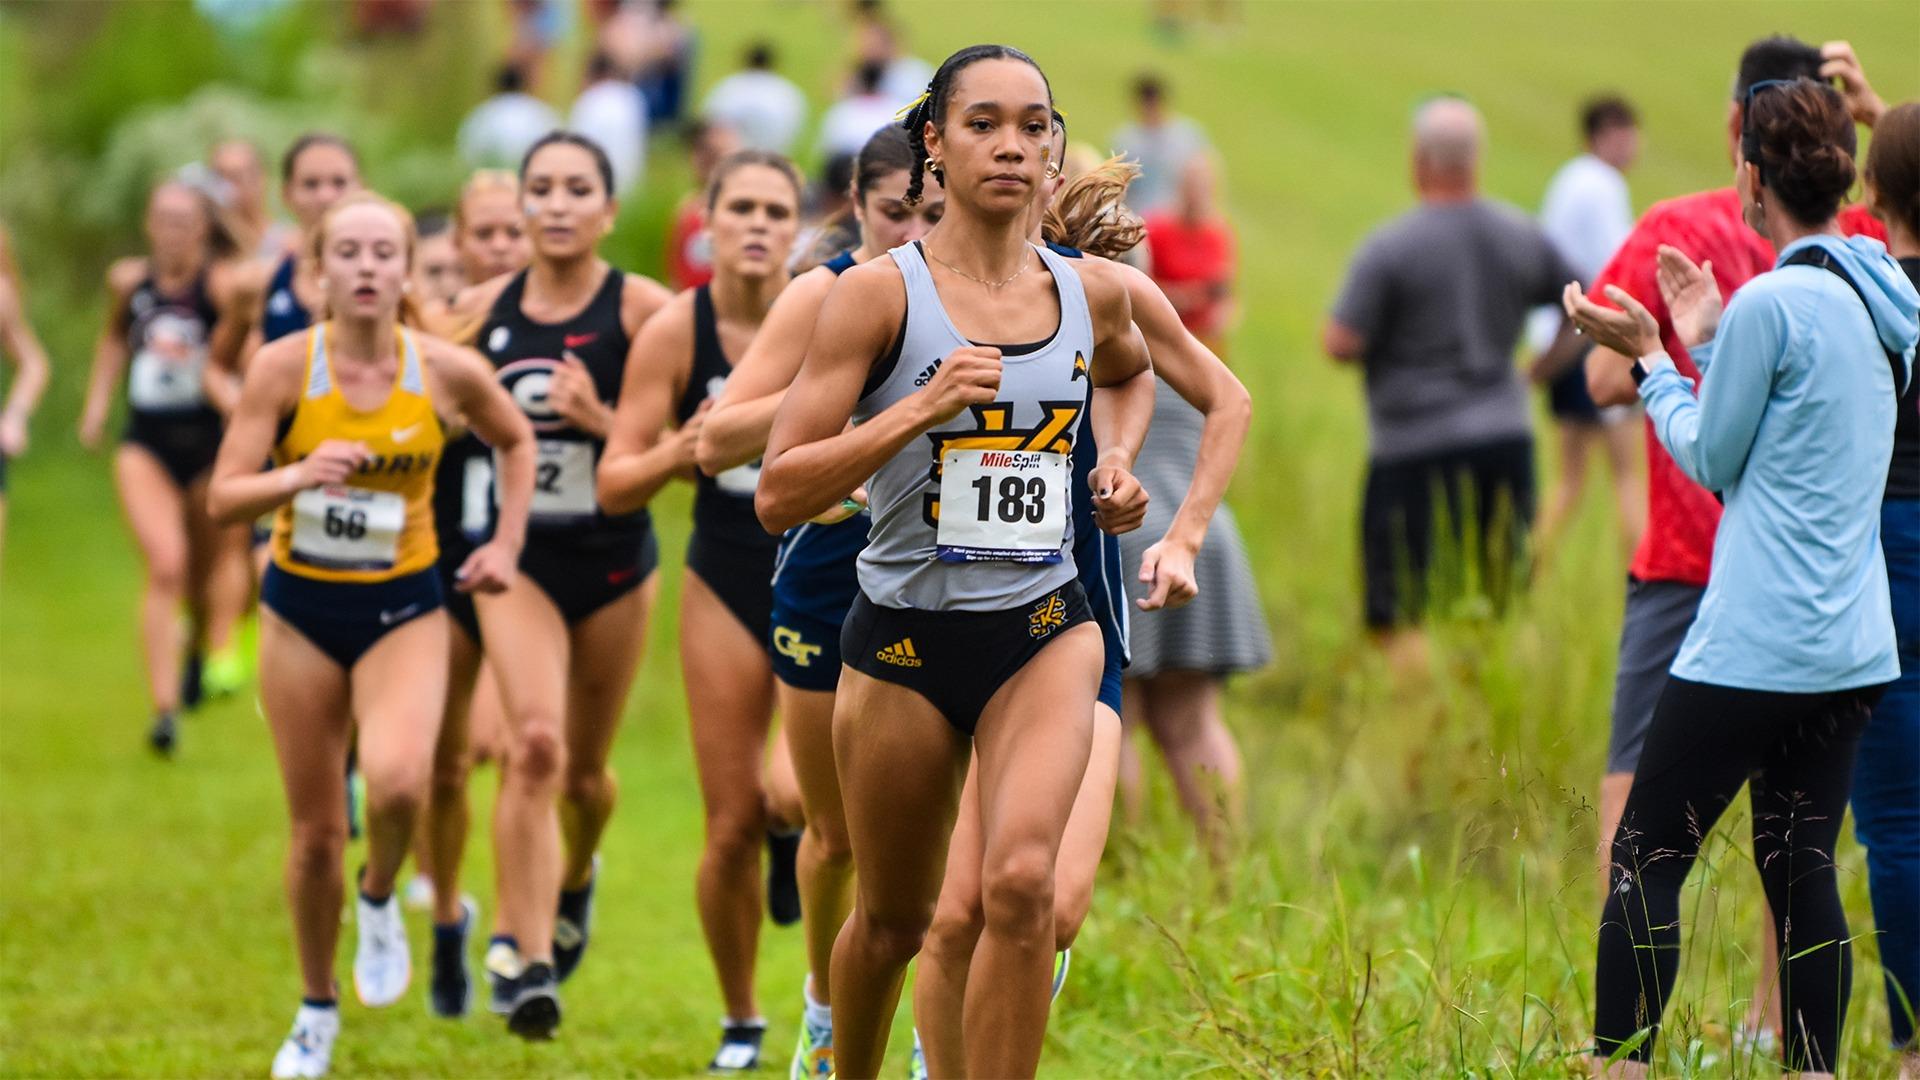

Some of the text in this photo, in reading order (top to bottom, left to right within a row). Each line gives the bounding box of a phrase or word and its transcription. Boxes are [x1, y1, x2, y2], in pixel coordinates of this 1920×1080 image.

[980, 452, 1041, 471] MileSplit
[972, 476, 1046, 523] 183
[773, 626, 821, 666] GT
[876, 650, 922, 667] adidas
